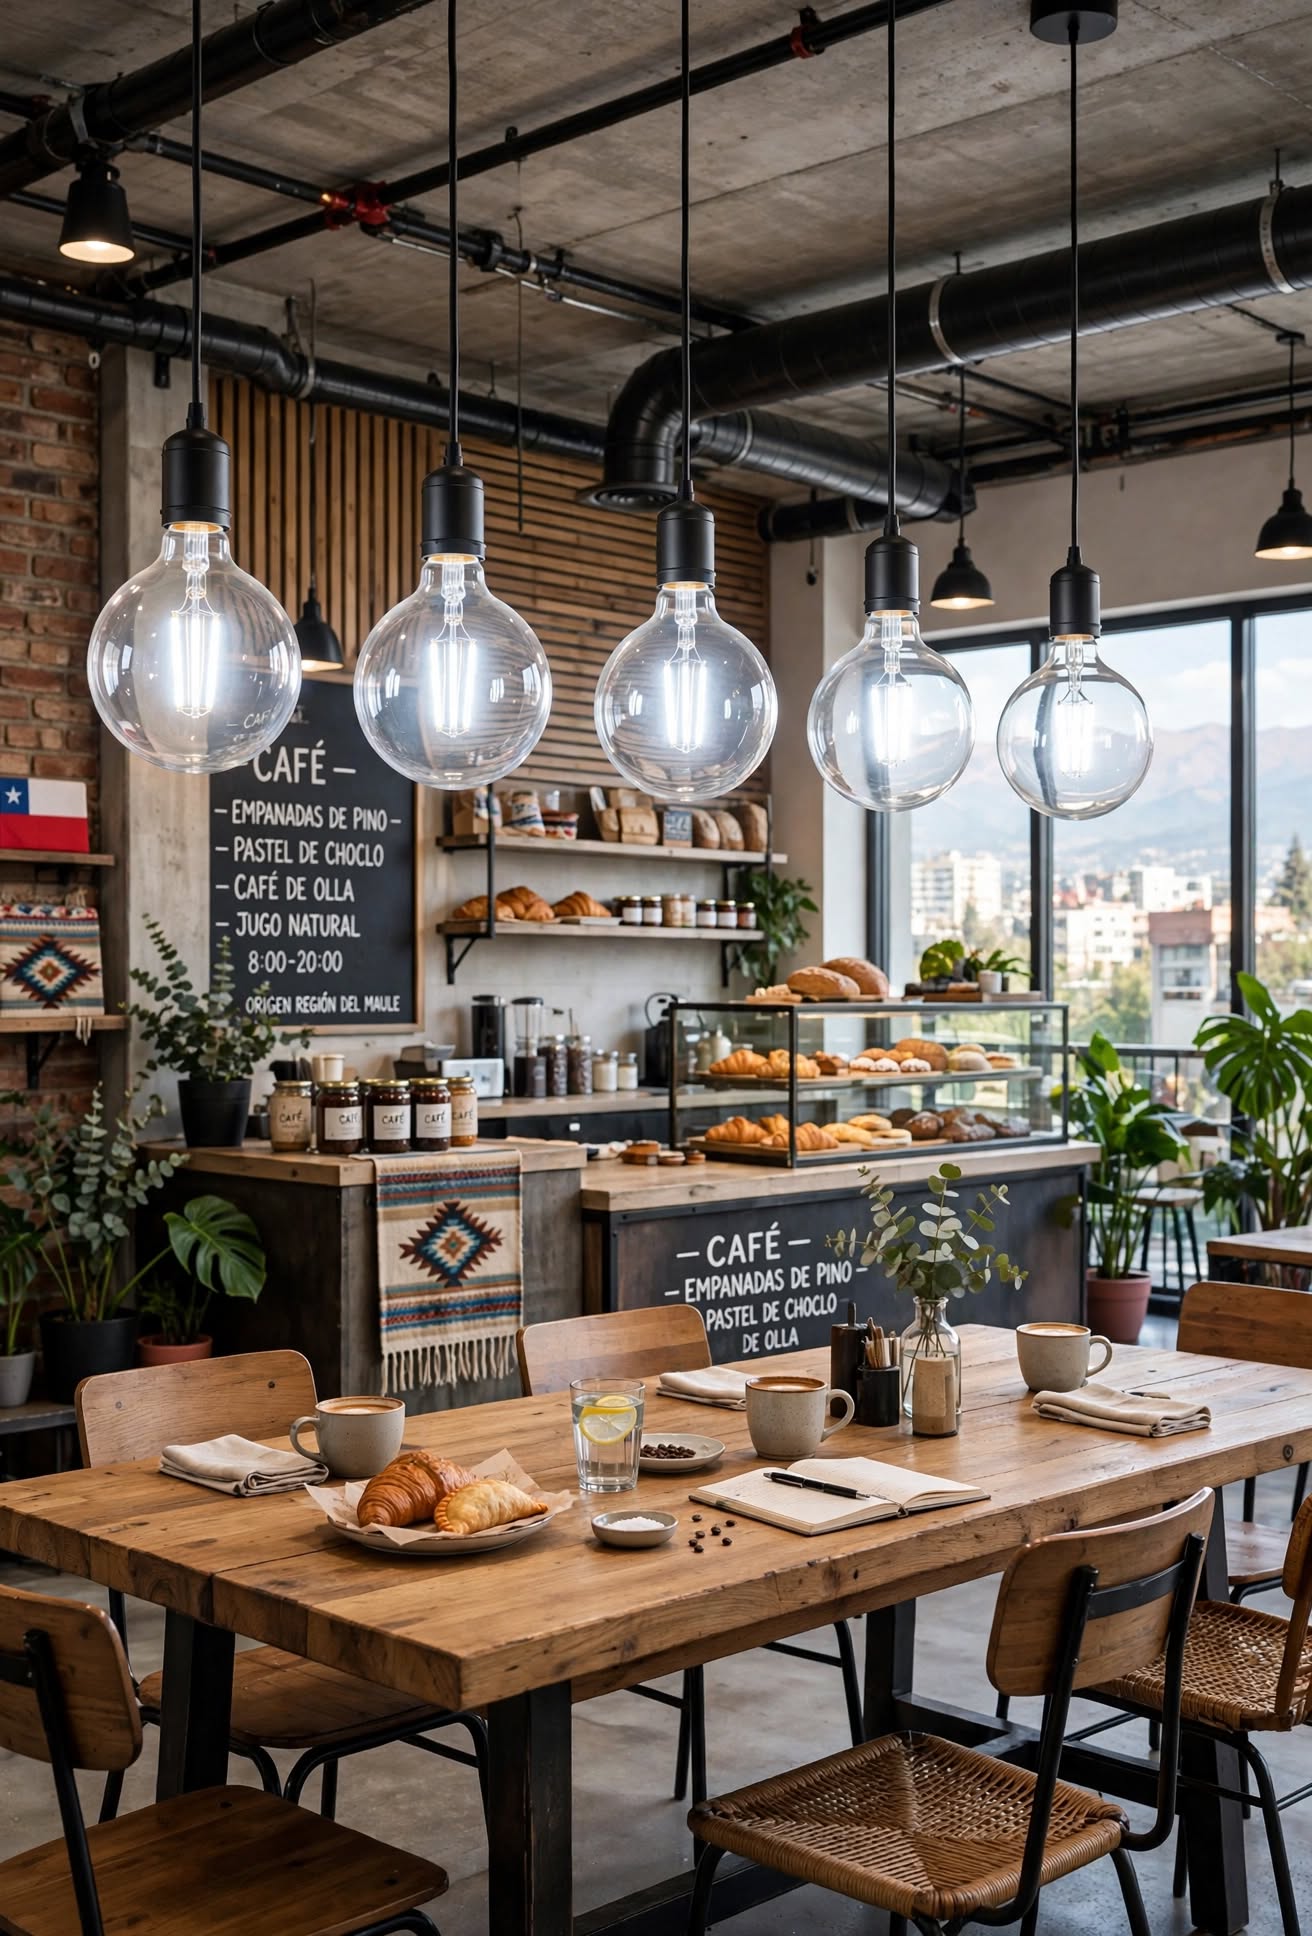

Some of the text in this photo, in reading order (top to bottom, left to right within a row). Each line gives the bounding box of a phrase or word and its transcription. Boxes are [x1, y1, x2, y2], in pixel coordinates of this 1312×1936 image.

[253, 739, 327, 785] CAFÉ
[232, 799, 388, 832] EMPANADAS DE PINO
[234, 836, 384, 867] PASTEL DE CHOCLO
[234, 871, 355, 902] CAFÉ DE OLLA
[235, 912, 360, 938] JUGO NATURAL
[248, 950, 343, 974] 8:00-20:00
[245, 995, 292, 1014] ORIGEN
[295, 991, 337, 1013] REGIÓN
[340, 995, 361, 1013] DEL
[425, 1111, 446, 1124] CAFÉ
[706, 1221, 781, 1267] CAFÉ
[685, 1260, 851, 1303] EMPANADAS DE PINO
[706, 1292, 837, 1332] PASTEL DE CHOCLO
[742, 1326, 799, 1353] DE OLLA
